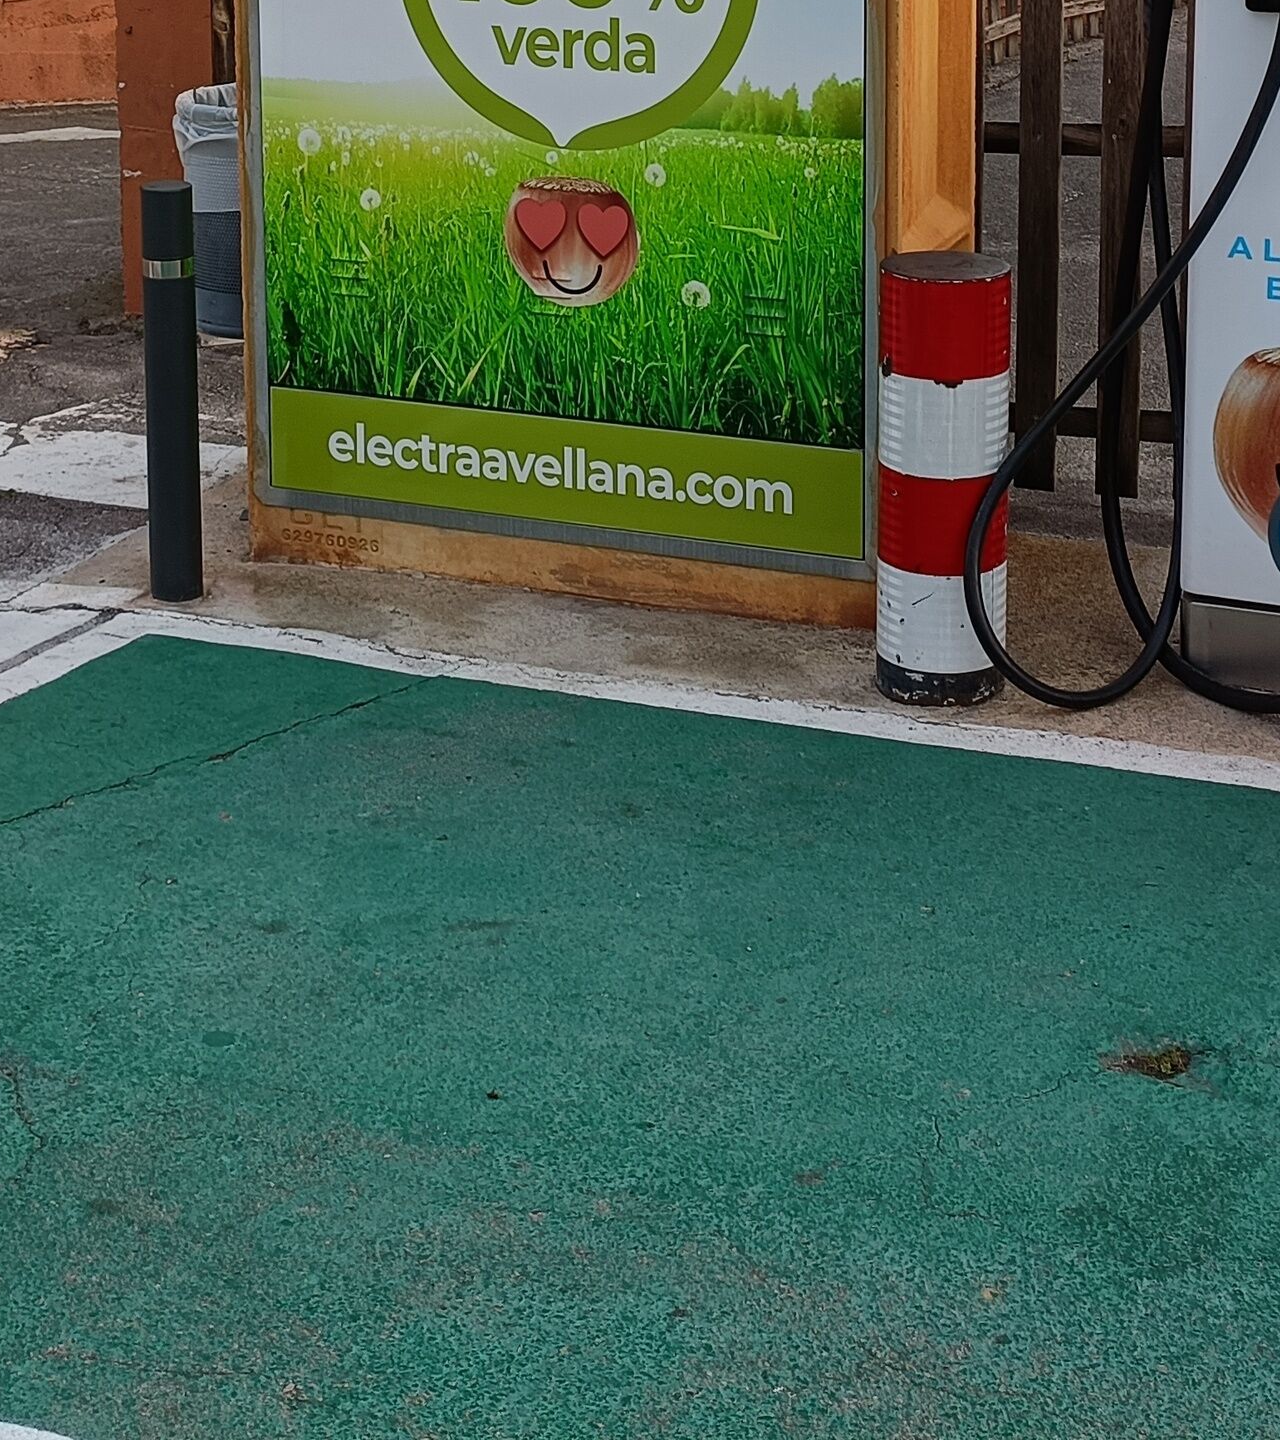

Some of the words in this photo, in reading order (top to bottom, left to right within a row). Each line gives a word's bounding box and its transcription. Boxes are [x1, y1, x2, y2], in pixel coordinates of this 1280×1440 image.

[491, 17, 656, 74] verda
[1228, 236, 1253, 260] A
[327, 422, 794, 515] electraavellana.com
